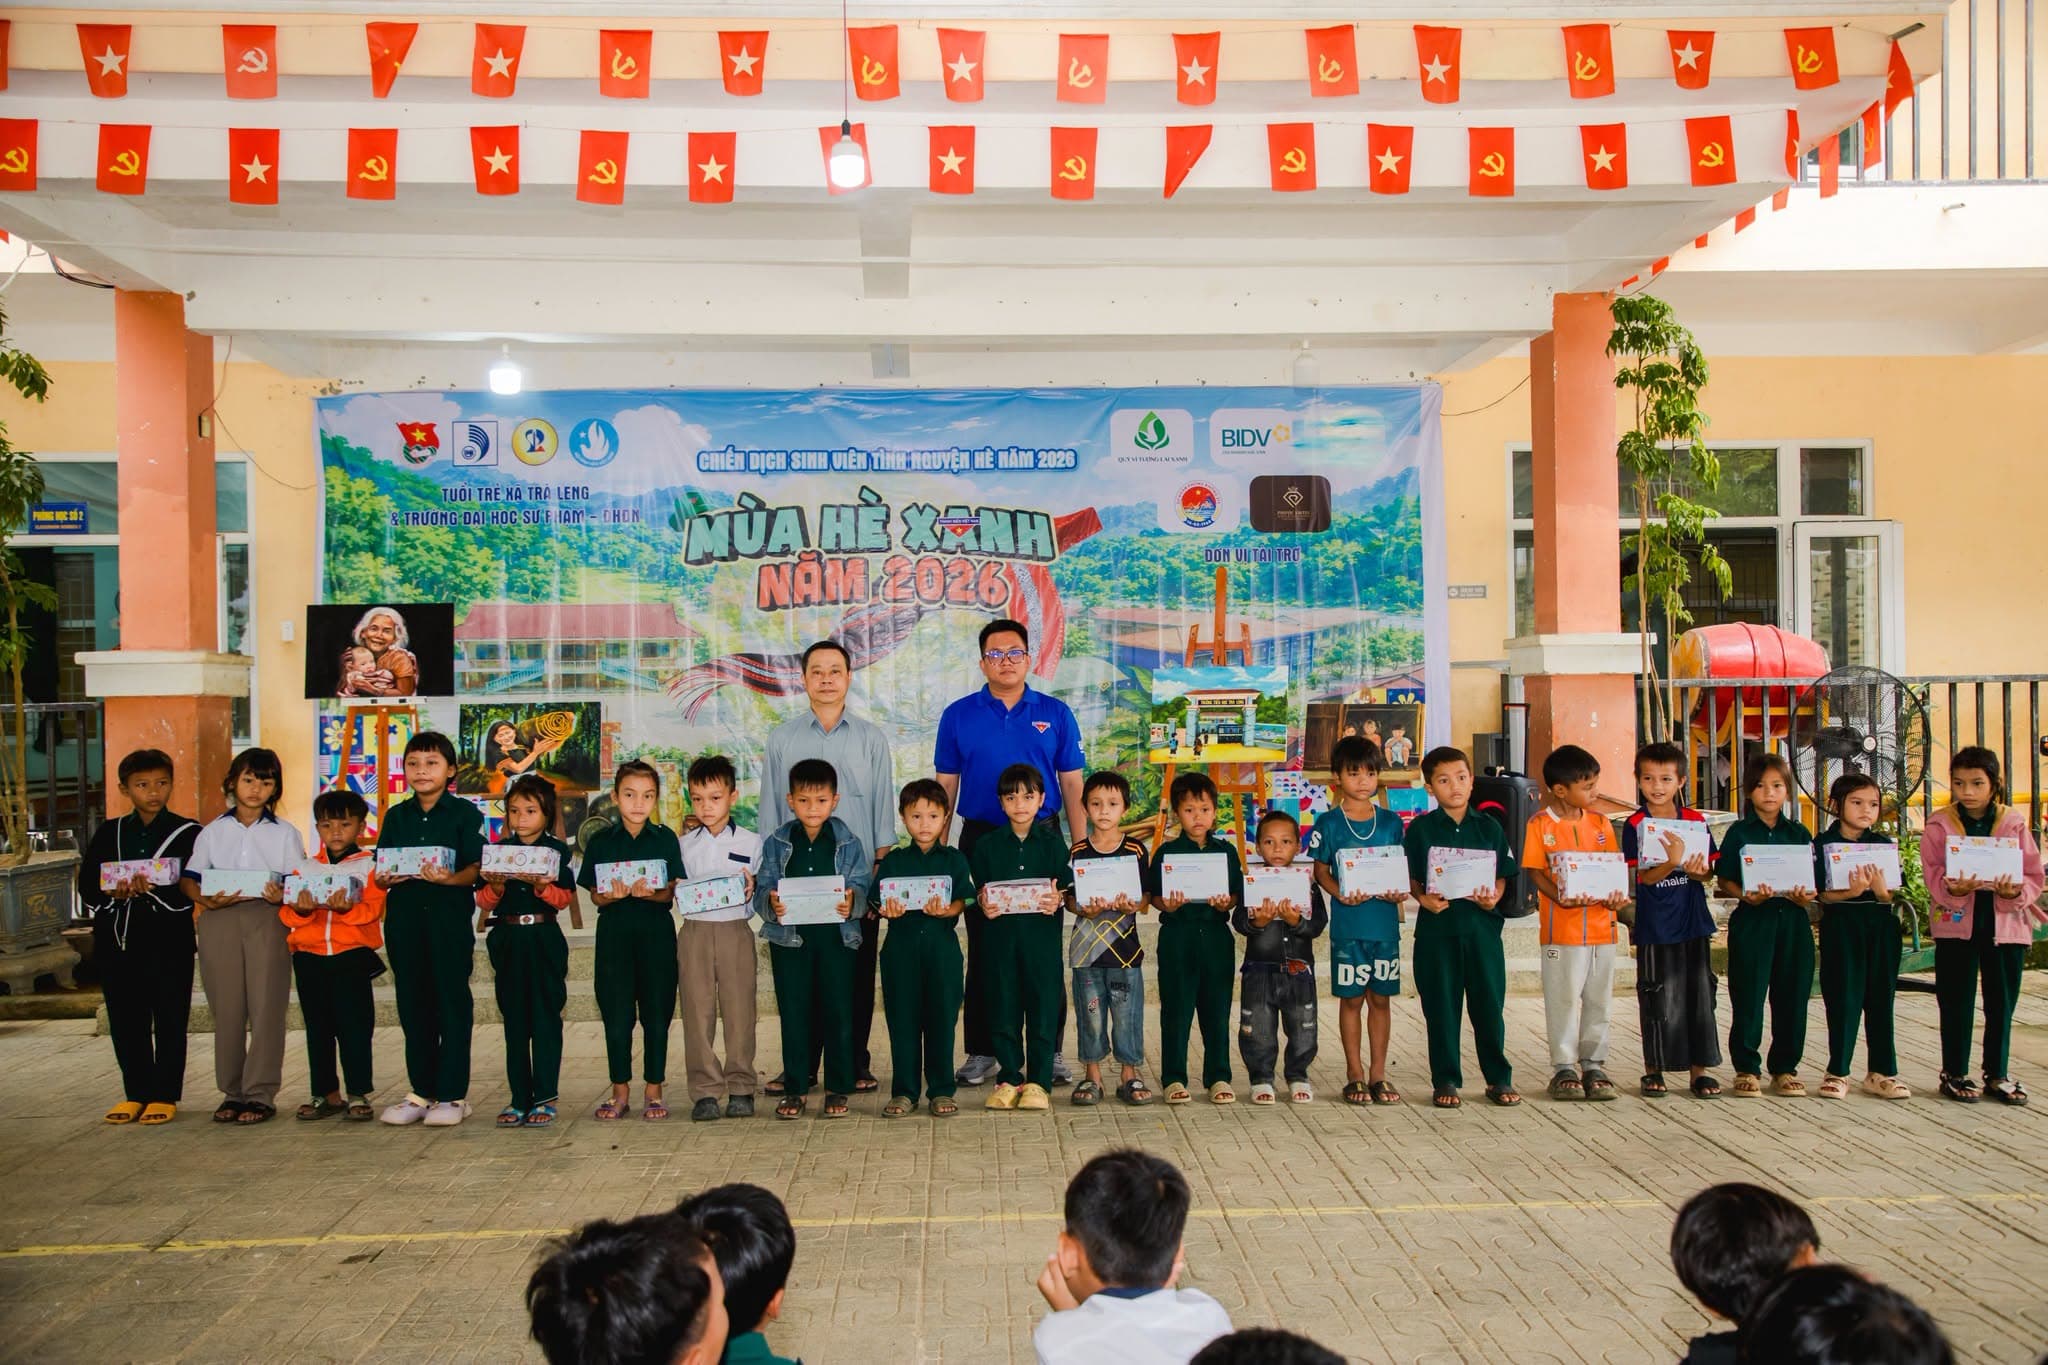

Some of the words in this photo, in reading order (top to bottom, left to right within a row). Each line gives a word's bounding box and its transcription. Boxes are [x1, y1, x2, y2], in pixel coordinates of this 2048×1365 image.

[1222, 429, 1272, 447] BIDV
[749, 450, 788, 475] DỊCH
[790, 450, 830, 471] SINH
[831, 447, 868, 471] VIÊN
[973, 446, 995, 470] HÈ
[997, 446, 1035, 470] NĂM
[1036, 449, 1077, 470] 2026
[557, 486, 589, 500] LENG
[391, 512, 399, 525] &
[491, 510, 518, 528] HỌC
[523, 509, 541, 524] SƯ
[684, 491, 812, 564] MÙA
[819, 485, 892, 554] HÈ
[901, 502, 1057, 563] XANH
[758, 550, 870, 611] NĂM
[881, 555, 1010, 610] 2026
